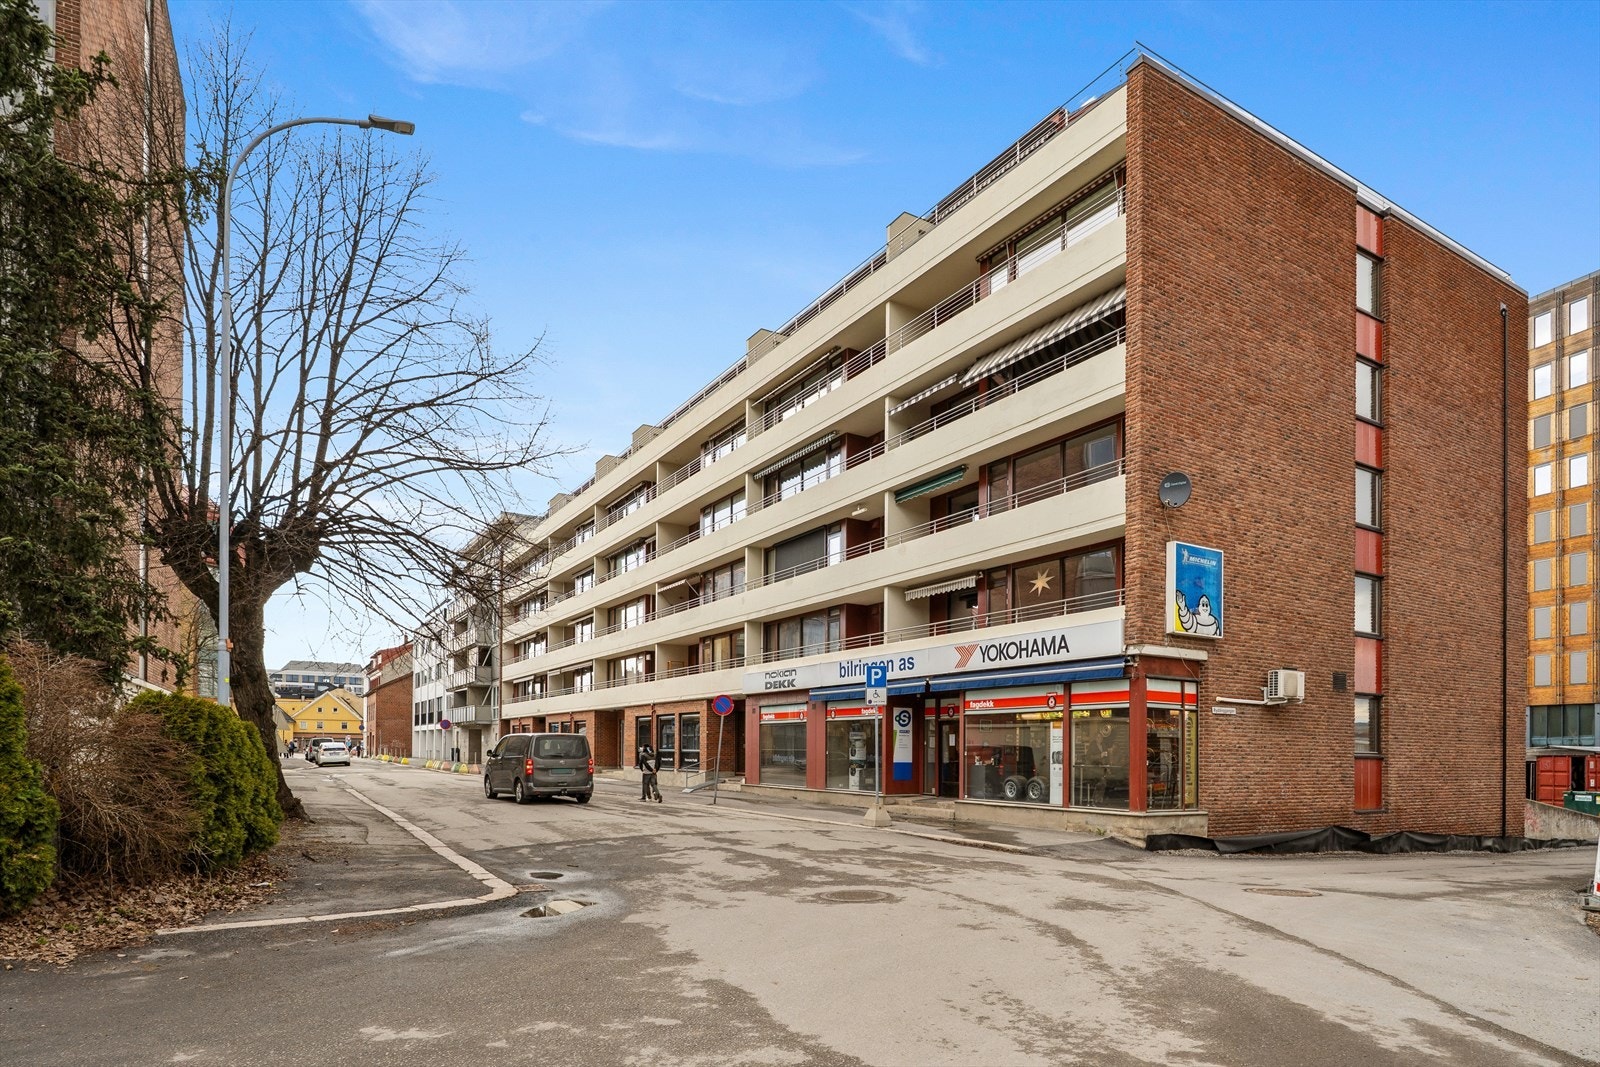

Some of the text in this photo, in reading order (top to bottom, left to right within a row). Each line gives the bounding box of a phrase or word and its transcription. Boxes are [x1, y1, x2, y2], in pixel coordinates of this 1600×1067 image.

[1189, 556, 1217, 567] MICHELIN
[979, 634, 1070, 663] YOKOHAMA
[899, 656, 915, 672] as
[765, 679, 797, 690] DEKK
[871, 668, 882, 686] P
